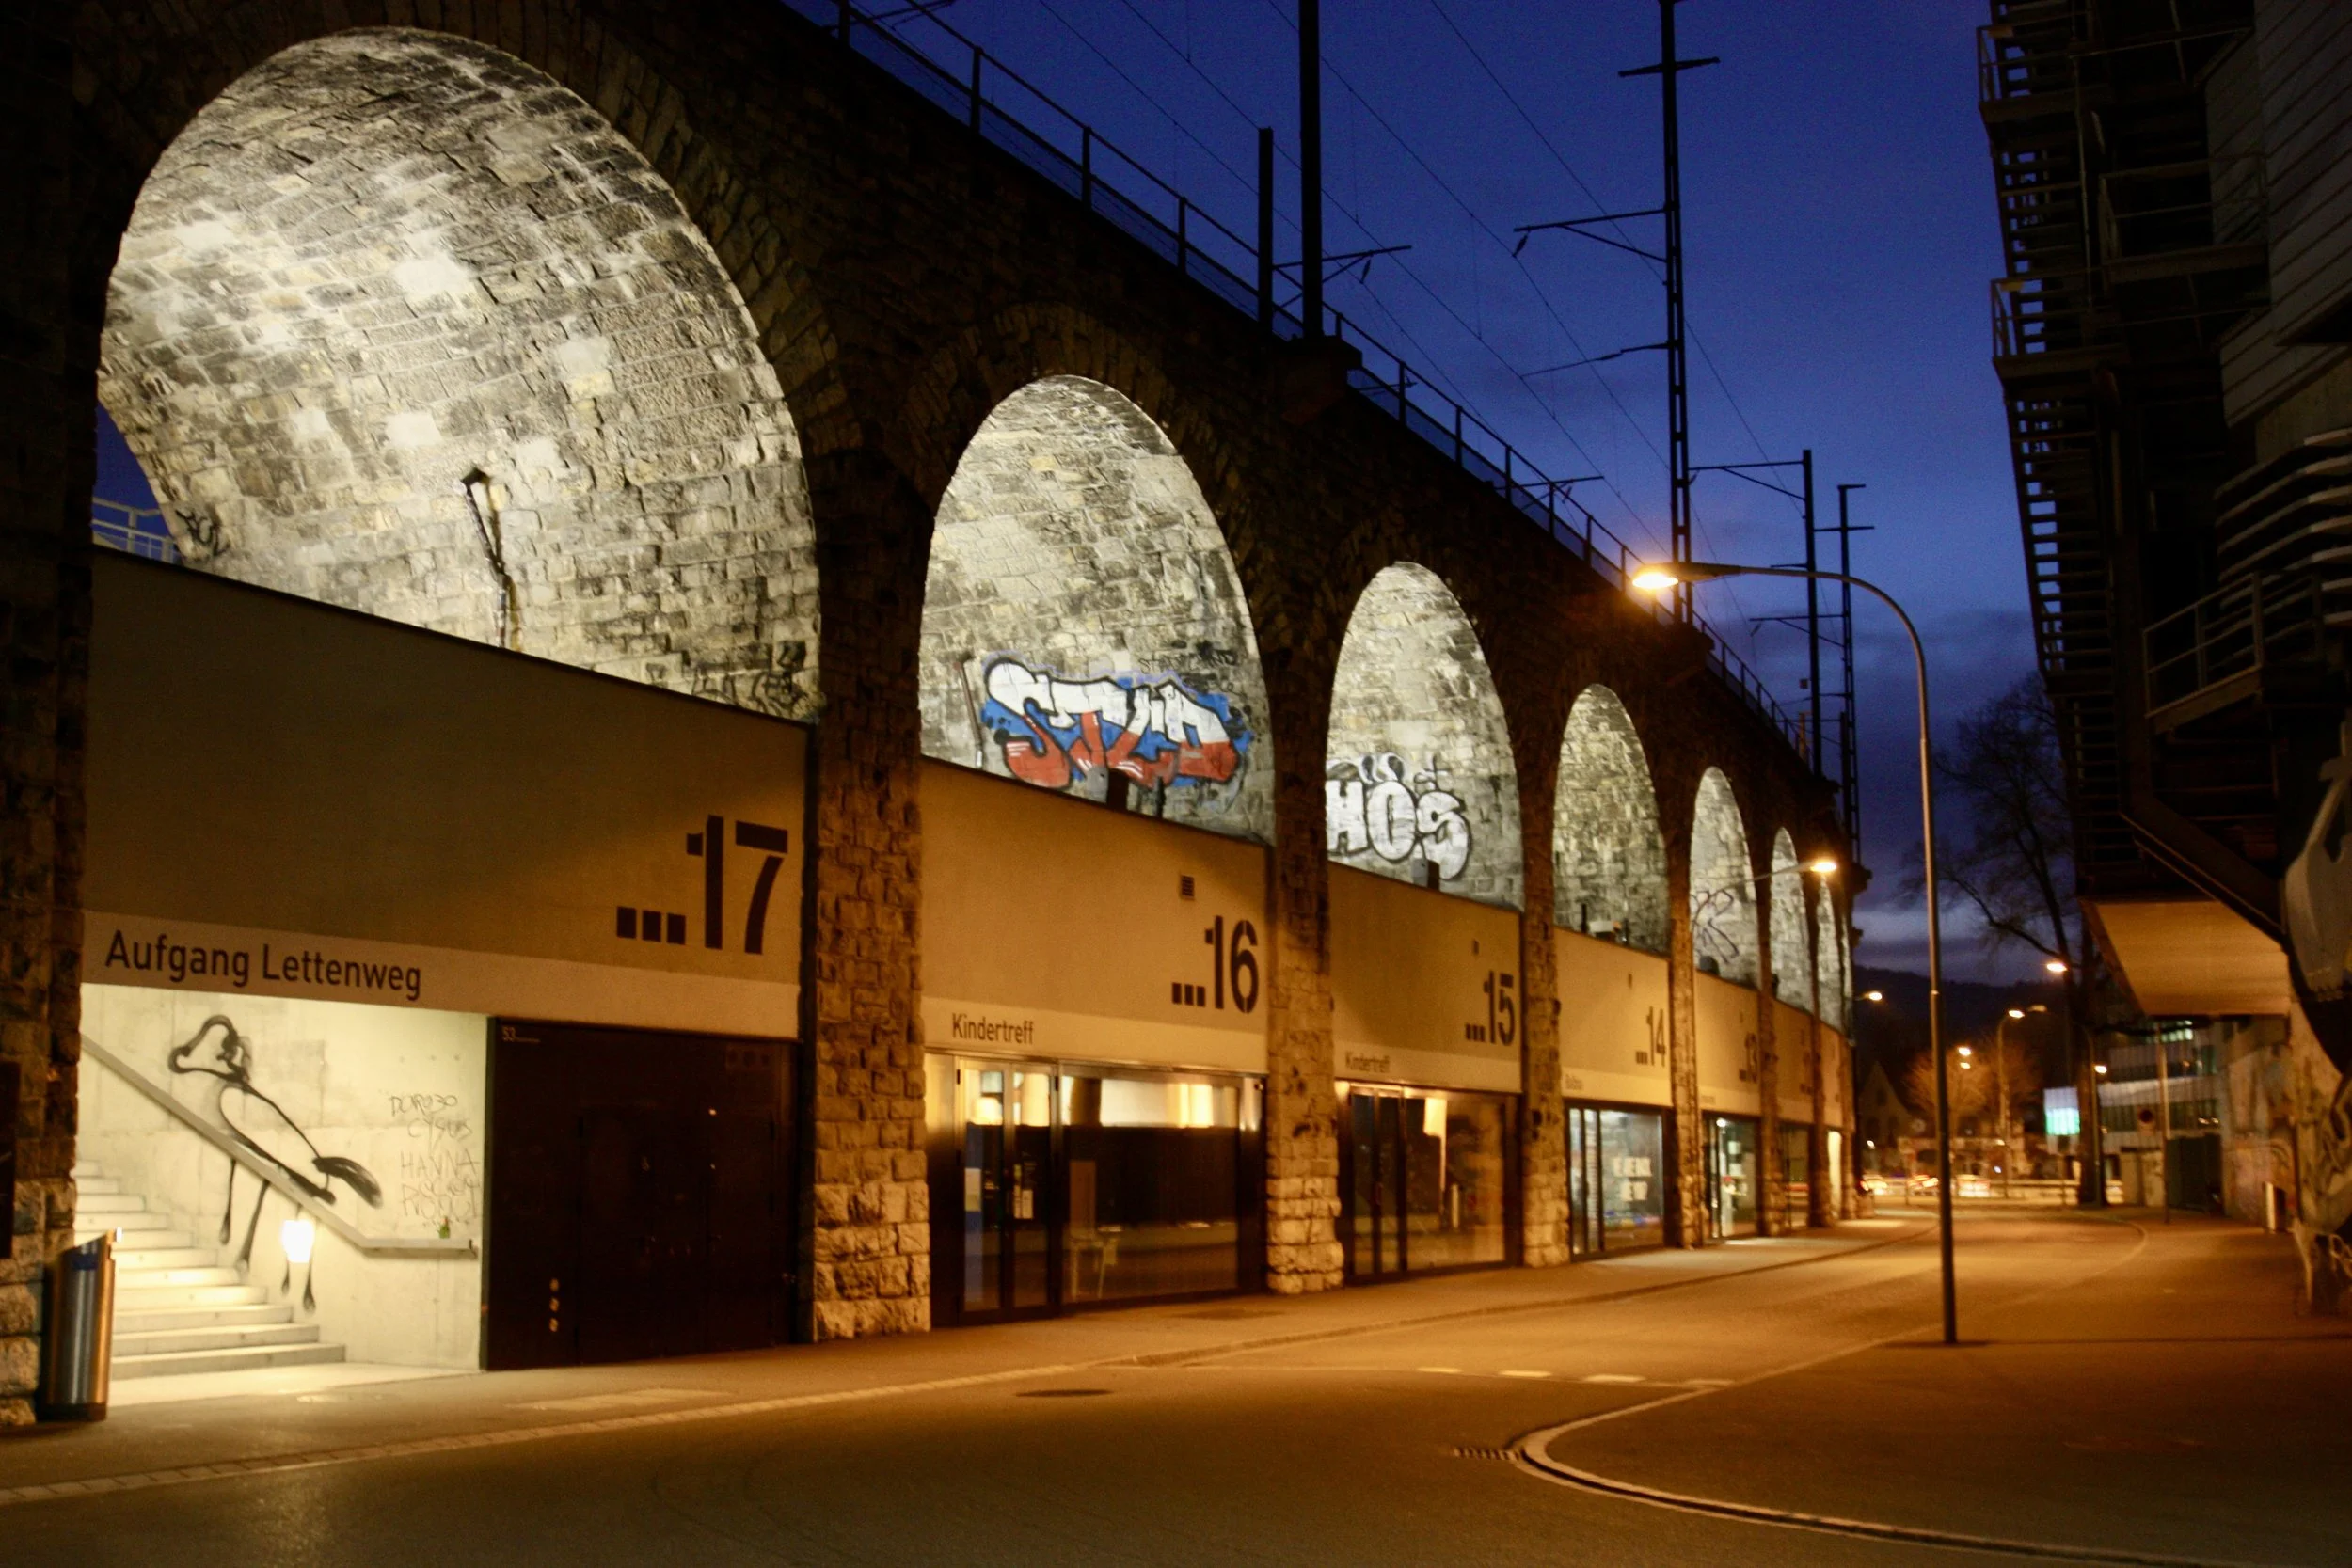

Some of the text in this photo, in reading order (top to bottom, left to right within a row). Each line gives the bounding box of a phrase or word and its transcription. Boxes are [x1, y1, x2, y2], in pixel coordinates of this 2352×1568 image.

[105, 929, 421, 1000] Aufgang Lettenweg
[952, 1014, 1034, 1046] Kindertreff
